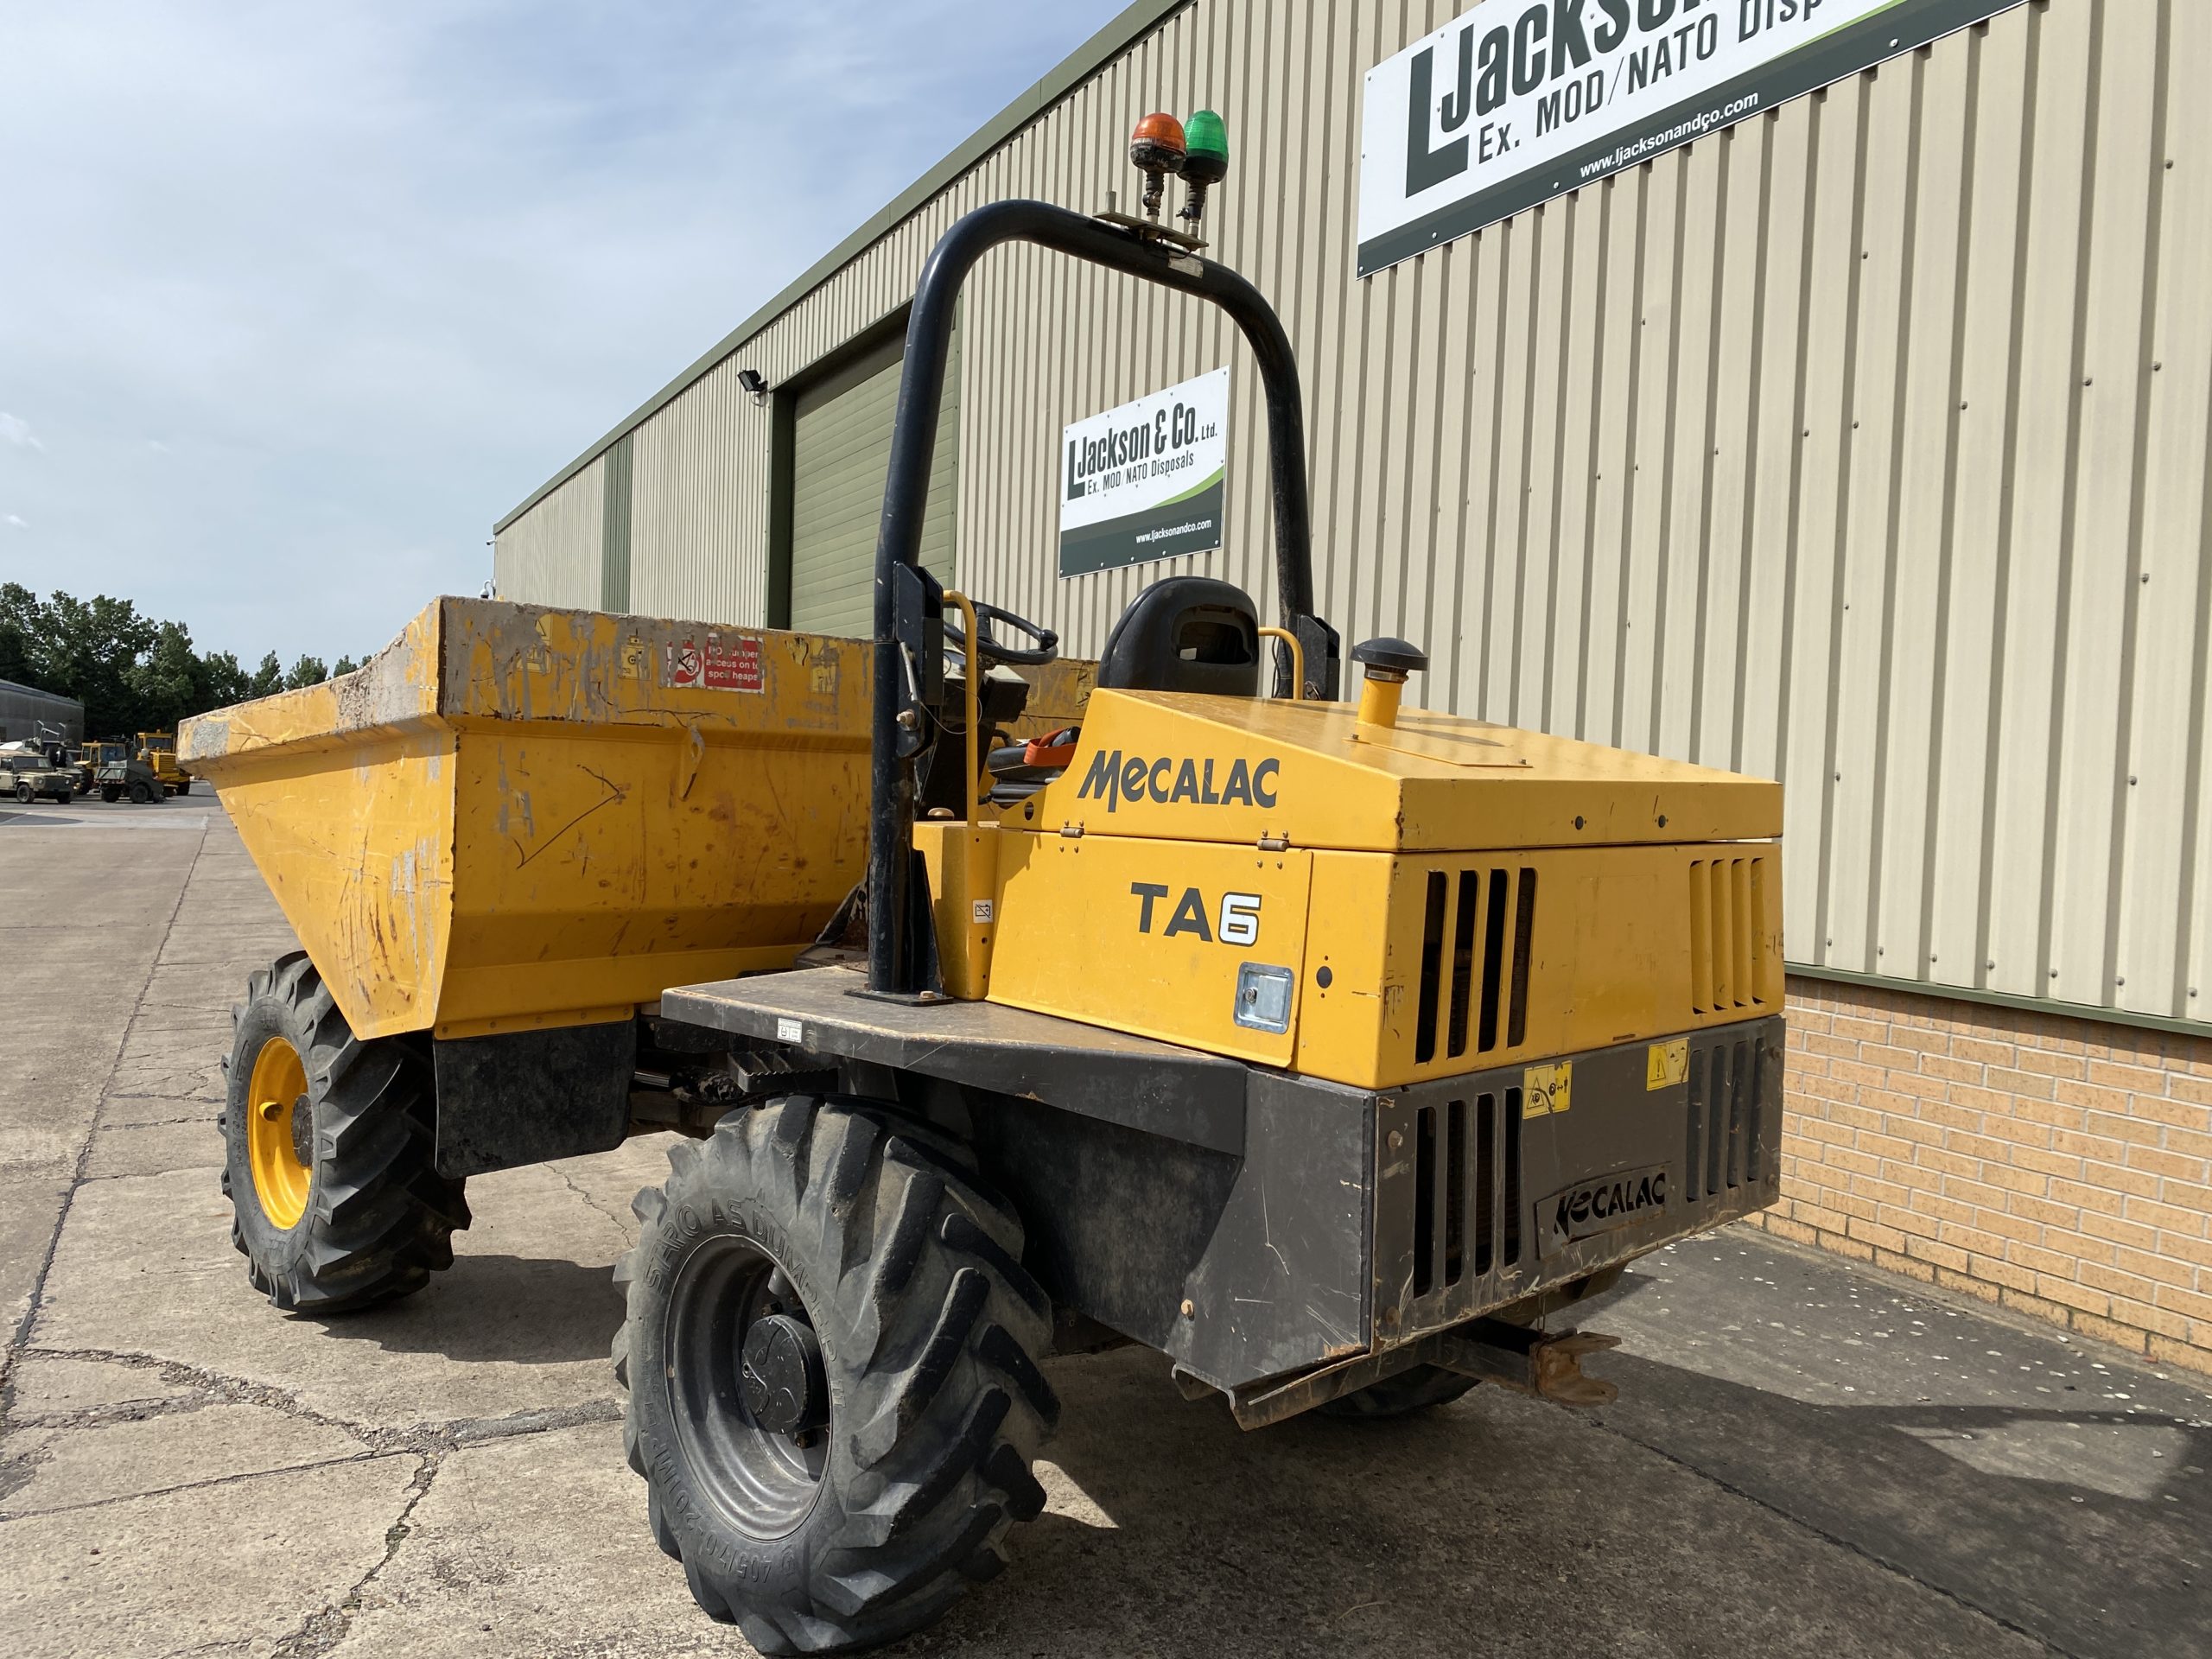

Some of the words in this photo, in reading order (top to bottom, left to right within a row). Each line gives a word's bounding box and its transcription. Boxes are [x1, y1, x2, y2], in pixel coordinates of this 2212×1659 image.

[1479, 122, 1521, 164] Ex.
[1536, 13, 1718, 137] MOD/NATO
[1580, 92, 1759, 178] www.ljacksonandco.com
[1154, 409, 1166, 455] &
[1172, 402, 1199, 450] Co.
[1201, 422, 1217, 441] Ltd.
[1088, 479, 1100, 495] Ex.
[1151, 449, 1194, 477] Disposals
[1135, 519, 1212, 544] www.ljacksonandco.com
[705, 658, 737, 668] acess
[732, 671, 758, 683] heaps
[1130, 882, 1262, 948] TA6
